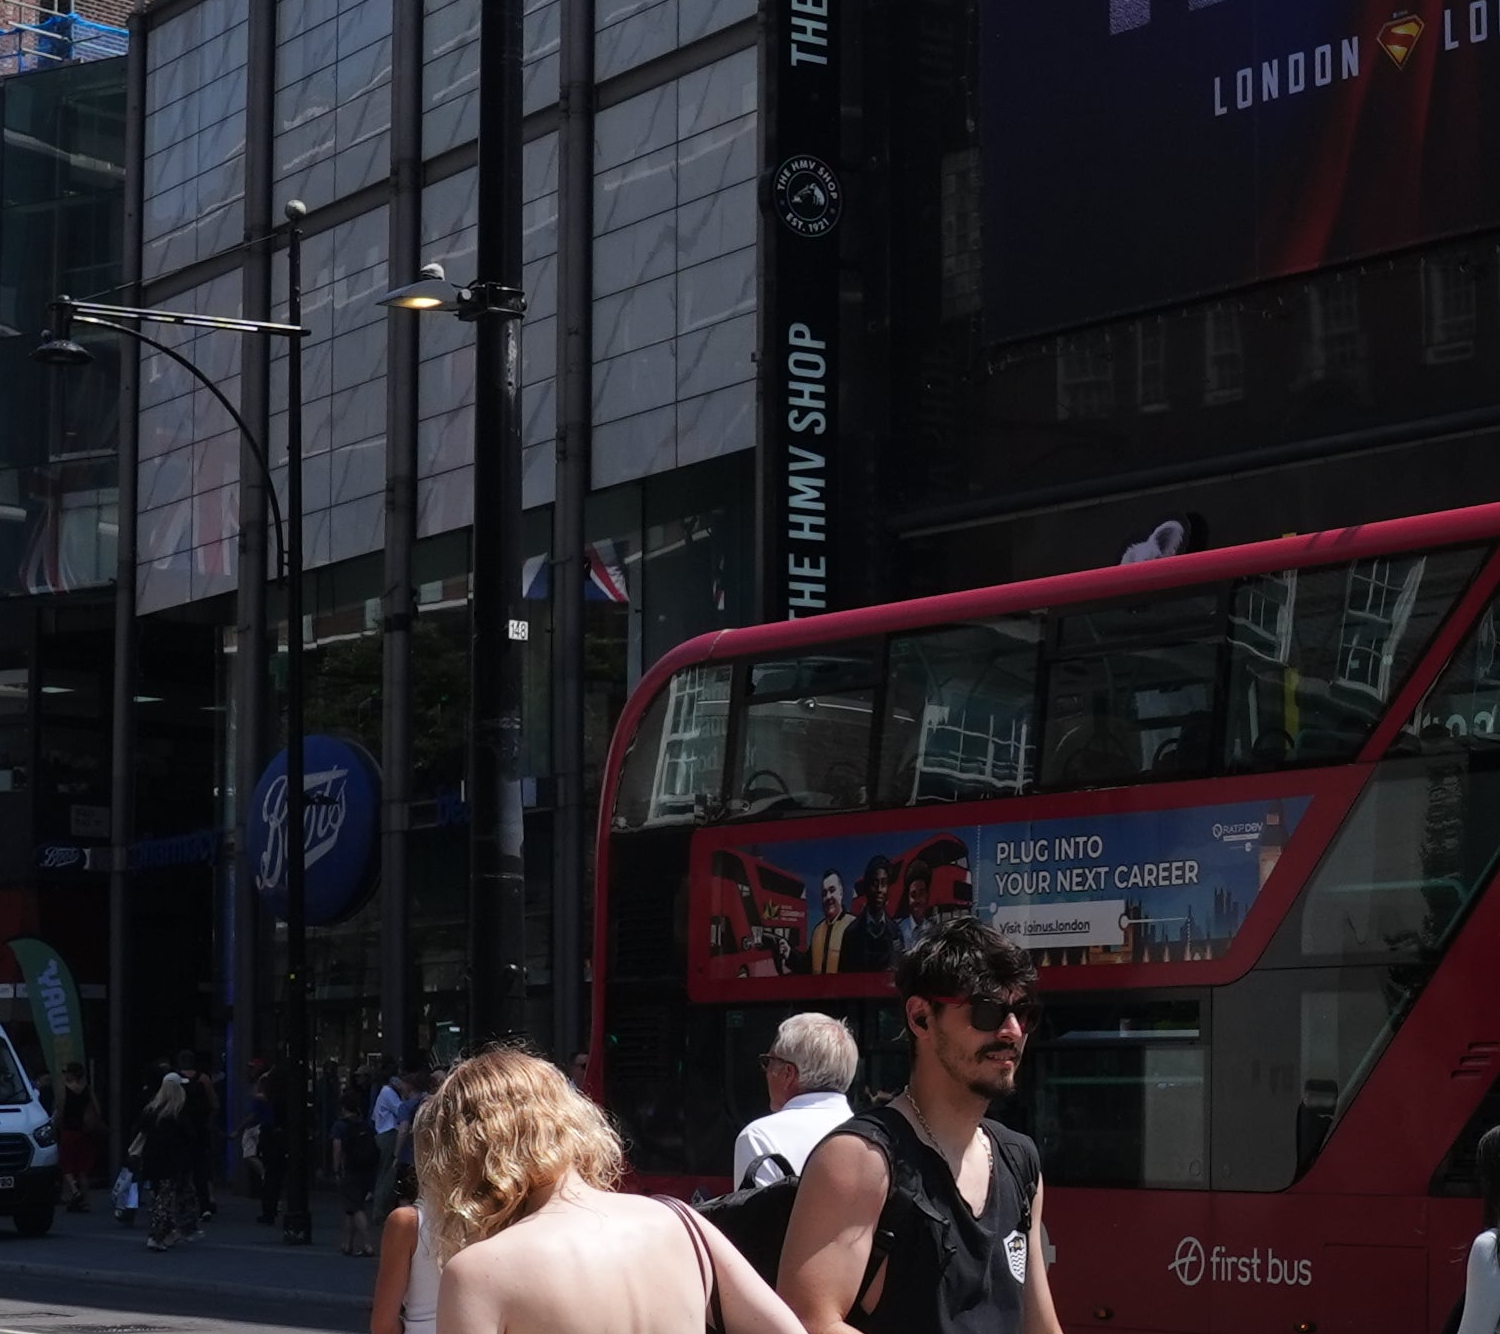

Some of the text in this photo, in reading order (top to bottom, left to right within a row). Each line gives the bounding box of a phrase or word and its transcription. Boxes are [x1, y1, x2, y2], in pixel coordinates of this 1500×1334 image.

[1213, 35, 1360, 117] LONDON
[777, 159, 838, 200] THE HMV SHOP
[787, 322, 827, 436] SHOP
[788, 445, 827, 542] HMV
[510, 622, 528, 639] 148
[996, 835, 1104, 865] PLUG INTO
[995, 860, 1200, 897] YOUR NEXT CAREER
[999, 919, 1091, 936] Visit joinus.london
[1210, 1245, 1313, 1286] first bus
